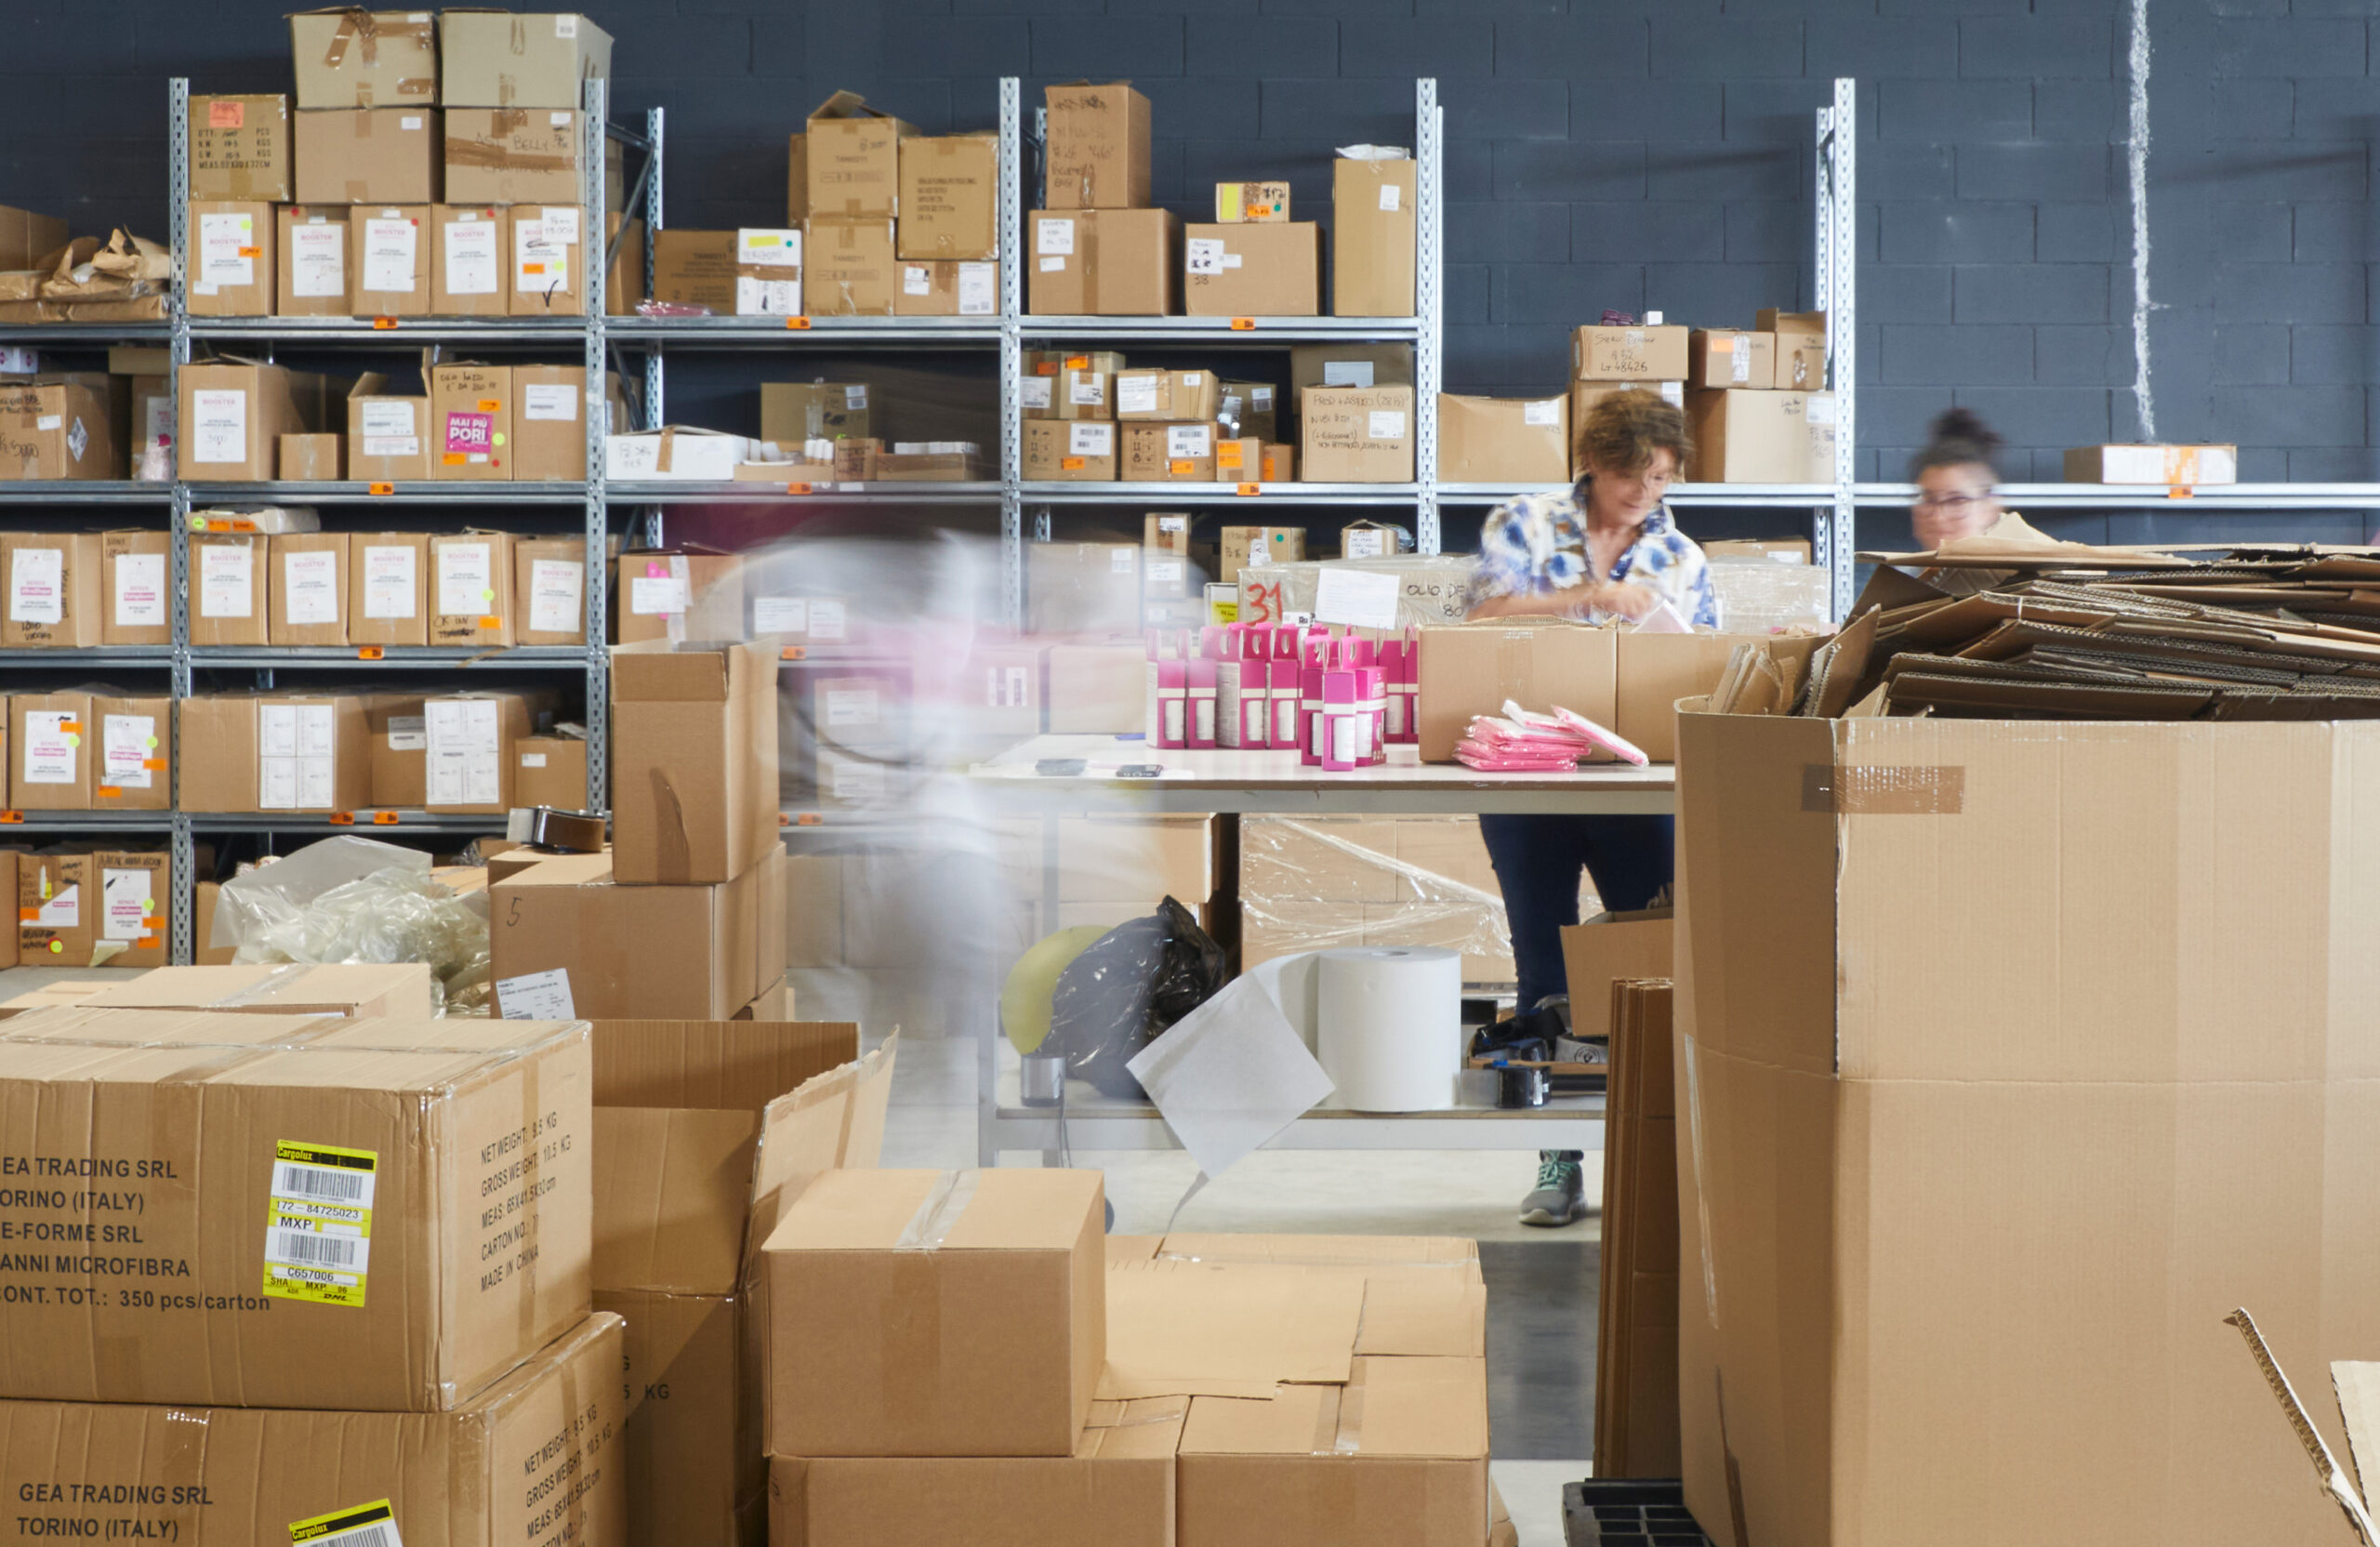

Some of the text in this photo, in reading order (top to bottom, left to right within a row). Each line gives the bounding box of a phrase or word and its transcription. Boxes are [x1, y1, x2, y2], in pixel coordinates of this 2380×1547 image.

[453, 231, 485, 239] BOOSTER
[450, 416, 488, 429] MAI PIÙ
[449, 427, 486, 442] PORI
[1246, 581, 1284, 627] 31
[1442, 603, 1465, 618] 80
[506, 896, 522, 927] 5
[481, 1142, 496, 1167] NET
[546, 1110, 558, 1130] KG
[277, 1146, 313, 1161] Cargolux
[481, 1169, 509, 1197] GROSS
[561, 1133, 571, 1154] KG
[2, 1157, 178, 1179] EA TRADING SRL
[0, 1188, 145, 1216] ORINO (ITALY)
[277, 1199, 295, 1211] 172
[306, 1203, 360, 1220] 84725023
[280, 1216, 312, 1230] MXP
[482, 1202, 506, 1230] MEAS:
[1, 1221, 144, 1244] E-FORME SRL
[481, 1229, 513, 1262] CARTON
[0, 1253, 191, 1277] ANNI MICROFIBRA
[286, 1266, 335, 1282] C657006
[481, 1242, 539, 1293] MADE IN CHINA
[270, 1276, 289, 1288] SHA
[305, 1280, 327, 1291] MXP
[0, 1285, 51, 1304] ONT.
[119, 1289, 154, 1308] 350
[160, 1290, 271, 1313] pcs/carton
[323, 1292, 348, 1302] DHL
[644, 1382, 670, 1401] KG
[523, 1449, 541, 1477] NET
[587, 1403, 598, 1425] KG
[526, 1473, 556, 1509] GROSS
[602, 1421, 613, 1444] KG
[19, 1482, 214, 1505] GEA TRADING SRL
[17, 1516, 179, 1543] TORINO (ITALY)
[291, 1523, 329, 1541] Cargolux
[526, 1507, 554, 1540] MEAS:
